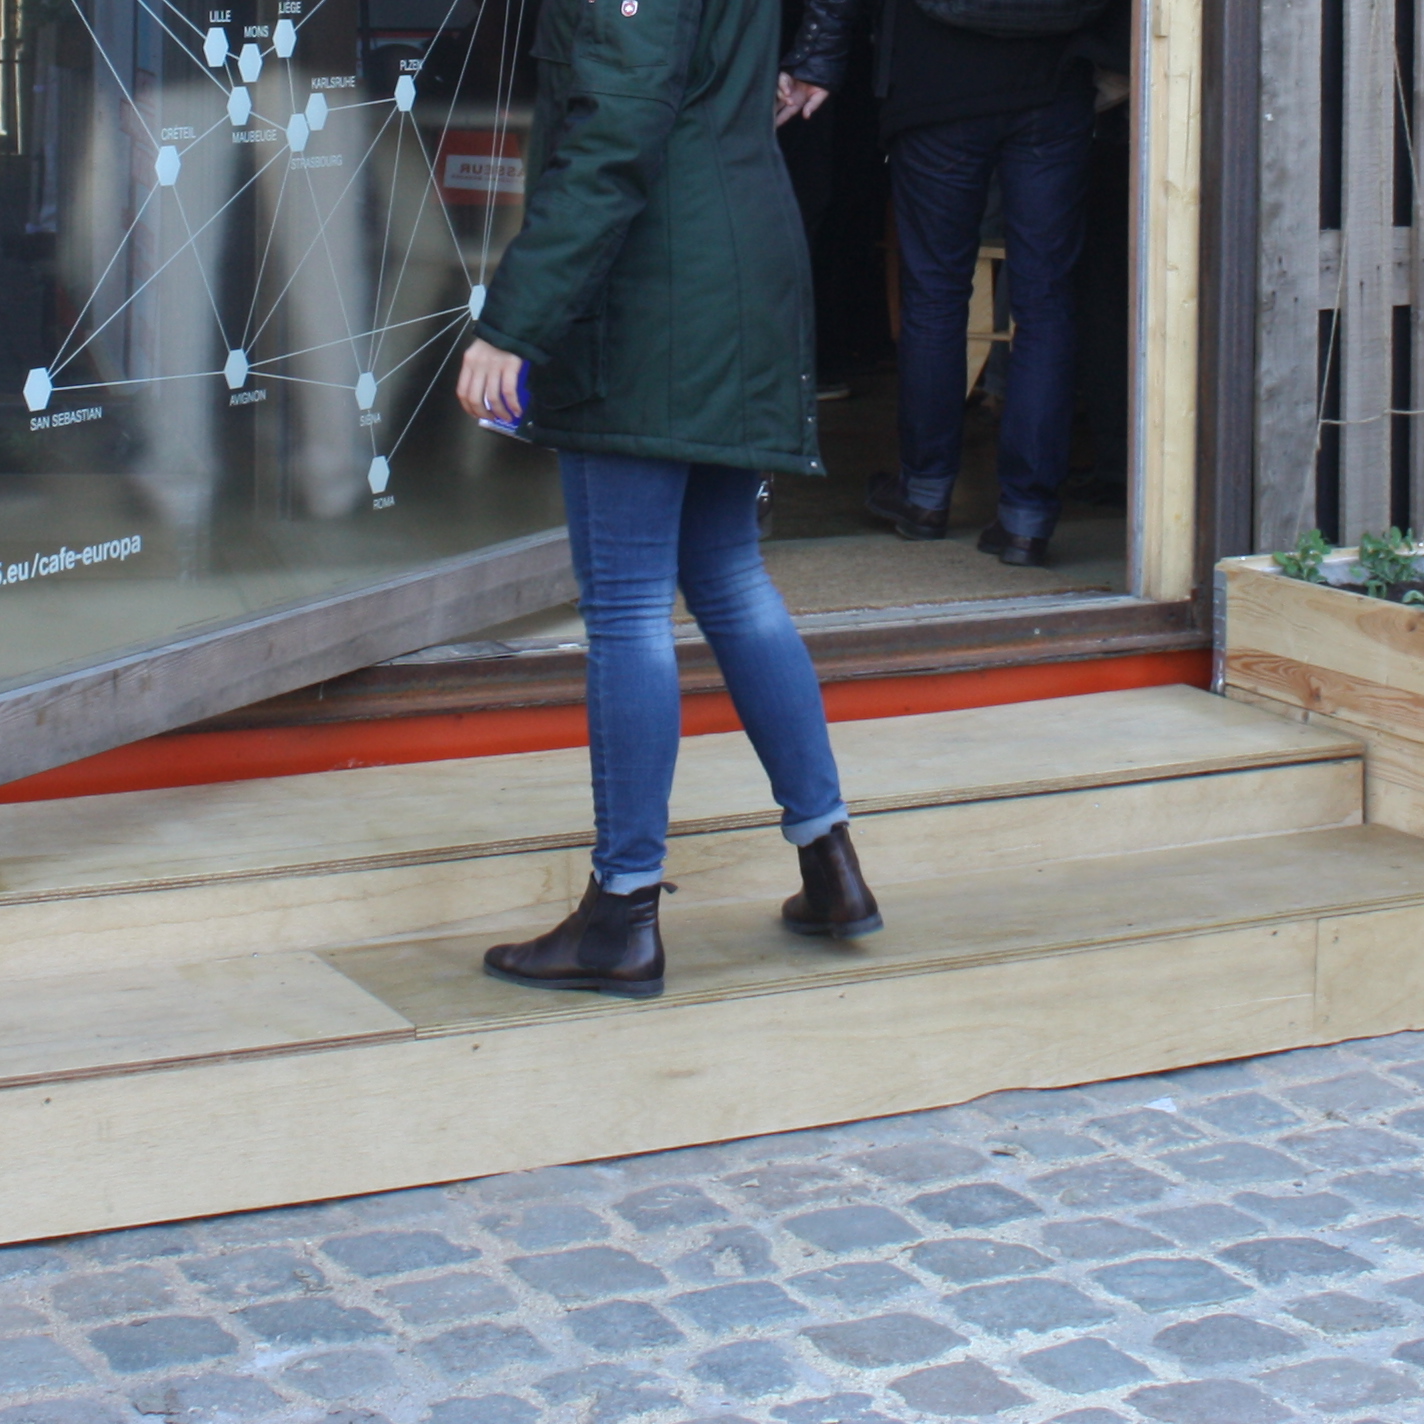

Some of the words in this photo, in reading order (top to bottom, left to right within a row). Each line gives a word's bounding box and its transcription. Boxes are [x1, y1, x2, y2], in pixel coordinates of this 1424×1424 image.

[209, 10, 232, 23] LILLE
[244, 25, 269, 38] MONS
[311, 76, 356, 89] KARLSRUHE
[232, 129, 277, 144] MAUBEUGE
[290, 155, 343, 170] STRASBOURG
[229, 389, 267, 407] AVIGNON
[30, 416, 50, 431] SAN
[51, 406, 103, 427] SEBASTIAN
[373, 495, 395, 510] ROMA
